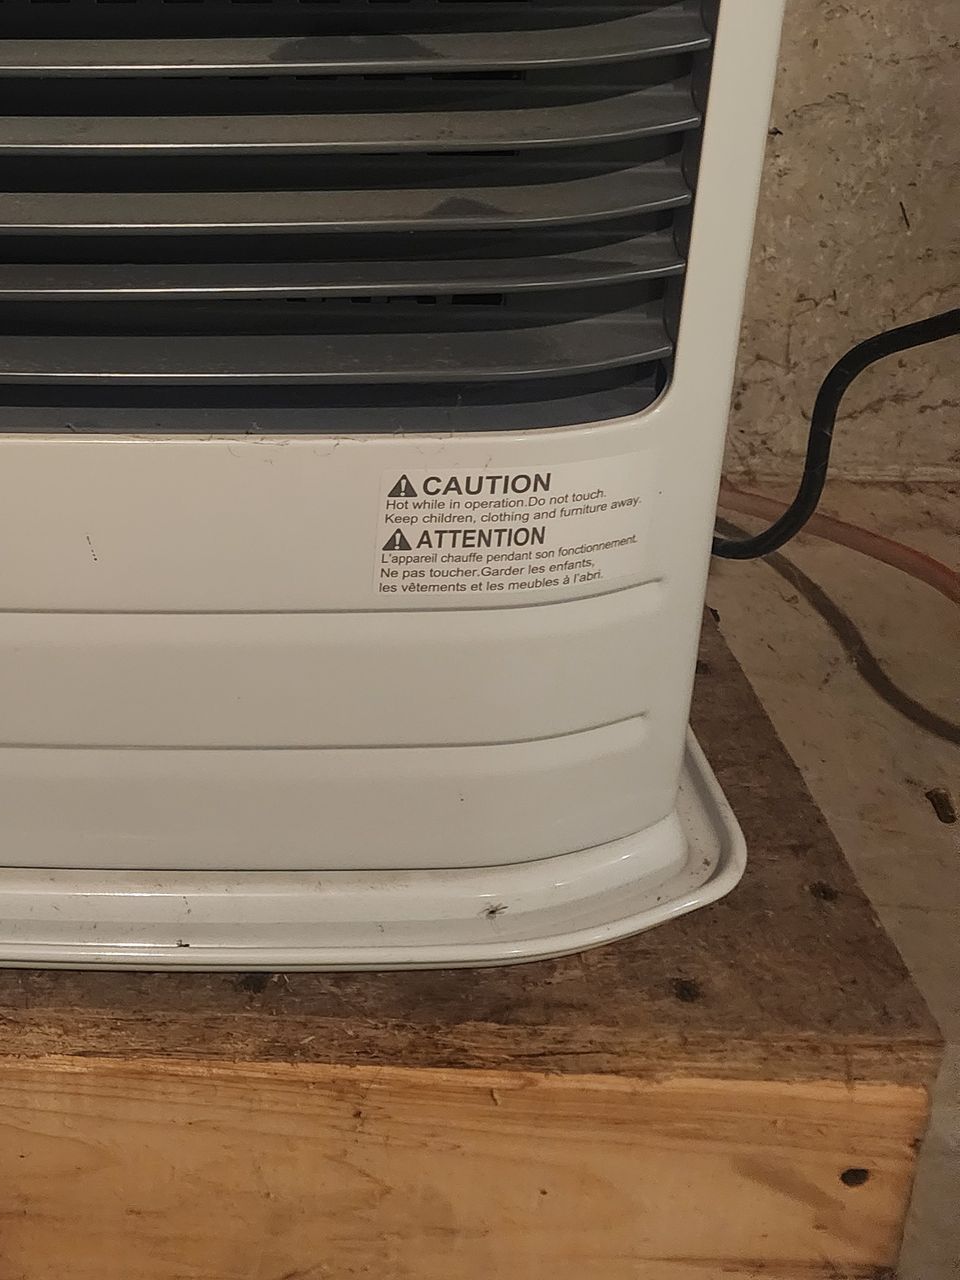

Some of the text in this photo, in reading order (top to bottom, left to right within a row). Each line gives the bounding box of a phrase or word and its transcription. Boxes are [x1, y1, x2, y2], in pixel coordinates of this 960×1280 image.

[422, 472, 551, 496] CAUTION
[386, 499, 408, 510] Hot
[412, 499, 445, 510] while
[449, 499, 460, 510] in
[549, 494, 569, 505] not
[572, 488, 606, 503] touch.
[385, 496, 642, 525] Keep children, clothing and furniture away.
[416, 526, 546, 549] ATTENTION
[381, 553, 438, 565] L'appareil
[440, 552, 483, 563] chauffe
[486, 551, 532, 564] pendant
[535, 549, 555, 560] son
[380, 568, 398, 578] Ne
[402, 568, 426, 580] pas
[528, 564, 545, 575] les
[548, 558, 595, 573] enfants,
[379, 582, 398, 593] les
[401, 582, 467, 593] vêtements
[470, 581, 483, 592] et
[486, 581, 504, 592] les
[508, 577, 559, 590] meubles
[562, 573, 570, 585] à
